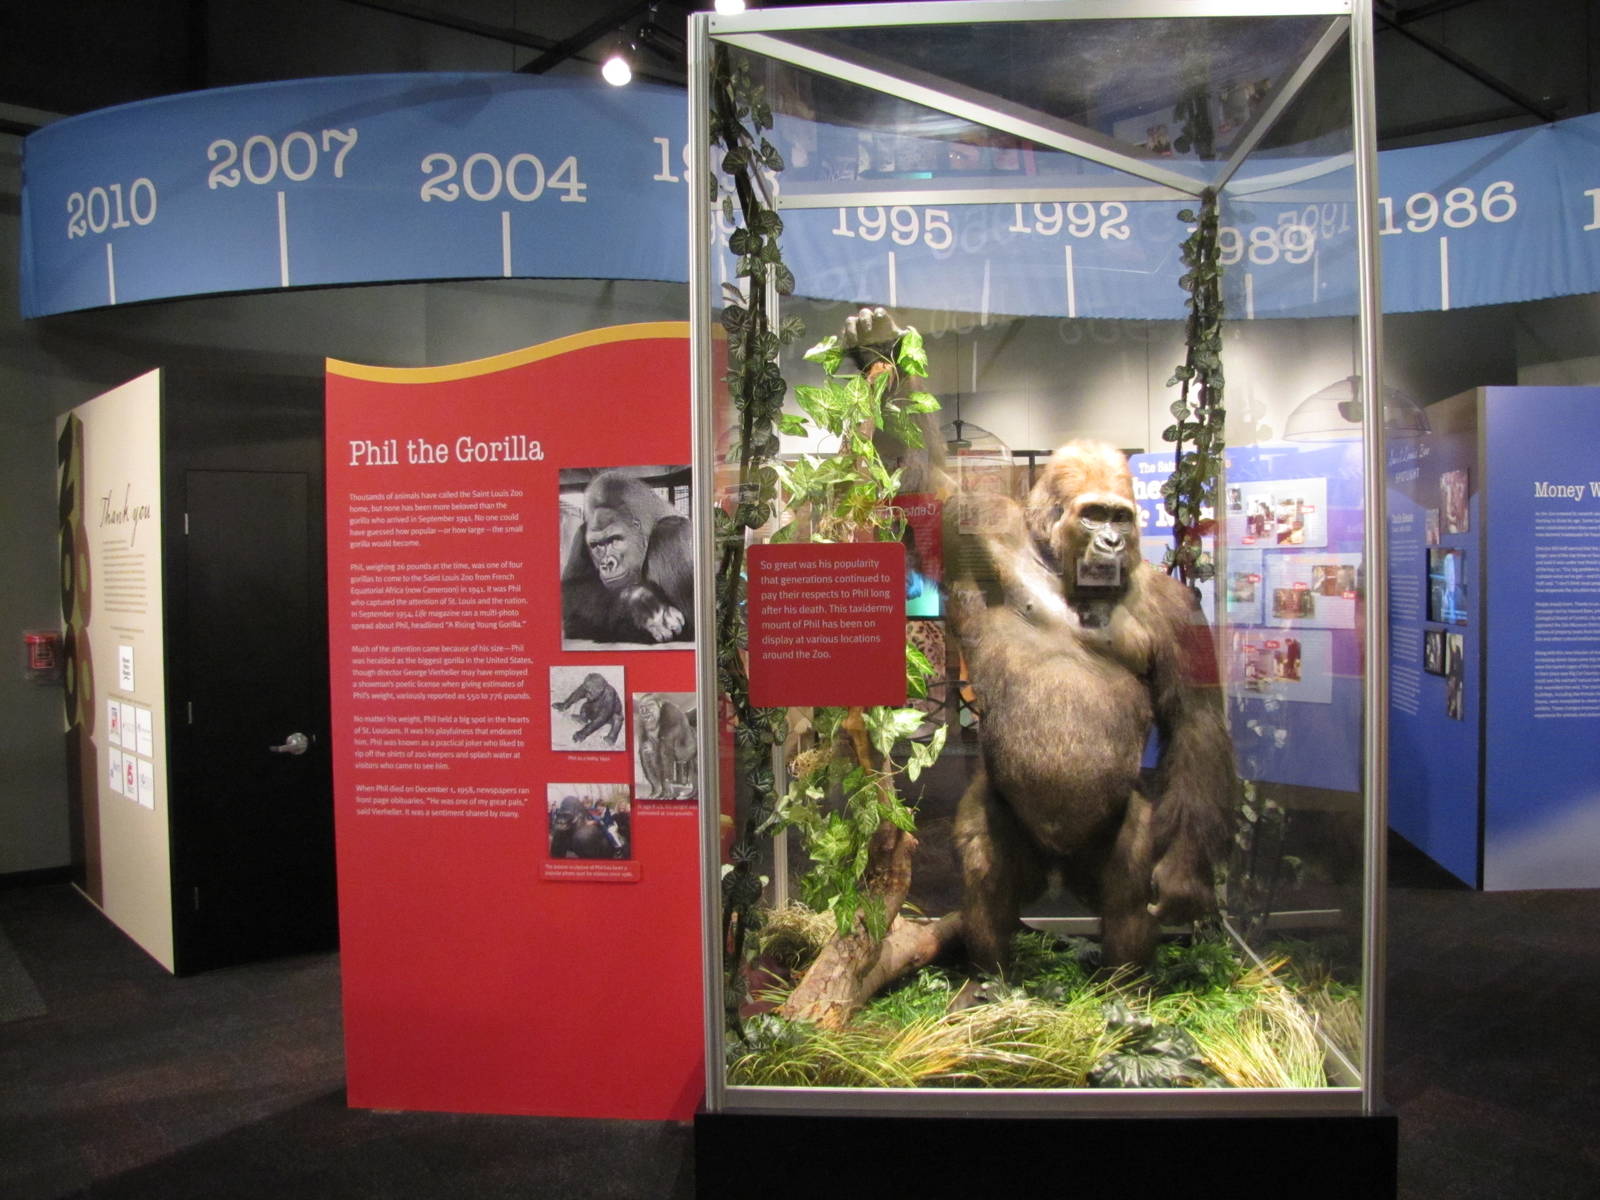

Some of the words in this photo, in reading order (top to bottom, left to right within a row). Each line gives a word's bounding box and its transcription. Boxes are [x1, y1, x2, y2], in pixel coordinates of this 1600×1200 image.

[207, 128, 357, 189] 2007
[420, 153, 587, 203] 2004
[67, 178, 157, 239] 2010
[1008, 201, 1130, 240] 1992
[1378, 181, 1517, 235] 1986
[832, 205, 953, 250] 1995
[1187, 225, 1315, 265] 989
[349, 440, 399, 466] Phil
[407, 438, 449, 464] the
[456, 435, 544, 463] Gorilla
[1534, 481, 1585, 502] Money
[100, 483, 130, 528] Thank
[132, 504, 150, 548] you
[761, 560, 772, 569] So
[774, 560, 796, 572] great
[818, 560, 831, 568] his
[833, 560, 879, 571] popularity
[761, 576, 778, 584] that
[780, 575, 832, 586] generations
[834, 574, 879, 583] continued
[881, 574, 890, 583] to
[761, 593, 776, 602] pay
[778, 591, 799, 599] their
[801, 590, 838, 601] respects
[840, 590, 849, 598] to
[851, 590, 868, 598] Phil
[870, 590, 890, 601] long
[761, 605, 781, 614] after
[783, 605, 797, 614] his
[799, 605, 827, 614] death.
[829, 605, 847, 613] This
[849, 604, 893, 616] taxidermy
[762, 620, 790, 629] mount
[792, 620, 801, 629] of
[803, 620, 820, 628] Phil
[822, 620, 838, 628] has
[840, 620, 862, 628] been
[762, 635, 793, 646] display
[795, 635, 804, 644] at
[806, 635, 838, 644] various
[840, 635, 880, 643] locations
[762, 650, 794, 658] around
[796, 650, 810, 658] the
[812, 650, 831, 658] Zoo.
